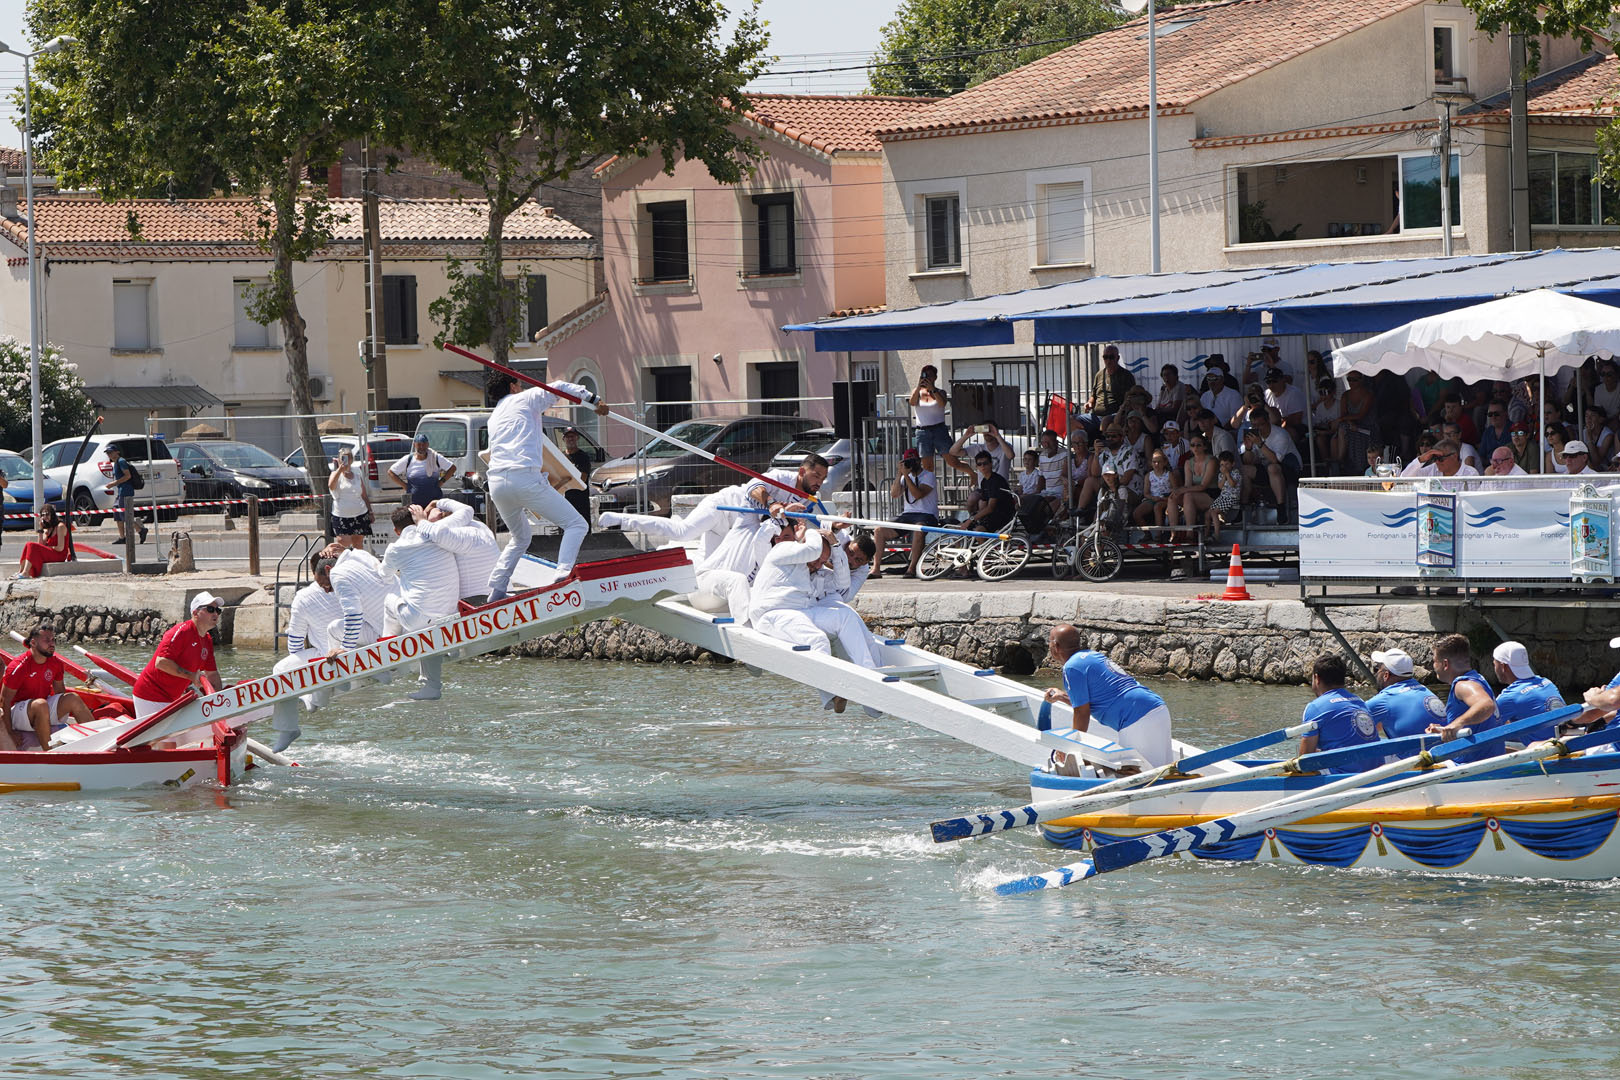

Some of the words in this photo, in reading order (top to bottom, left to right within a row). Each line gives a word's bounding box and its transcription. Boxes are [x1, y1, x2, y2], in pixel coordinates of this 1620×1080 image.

[1322, 532, 1347, 540] Peyrade
[1367, 532, 1400, 540] Frontignan
[1493, 531, 1520, 540] Peyrade
[599, 580, 619, 593] SJF
[623, 576, 667, 589] FRONTIGNAN
[235, 646, 382, 708] FRONTIGNAN
[388, 630, 435, 662] SON
[440, 598, 540, 647] MUSCAT
